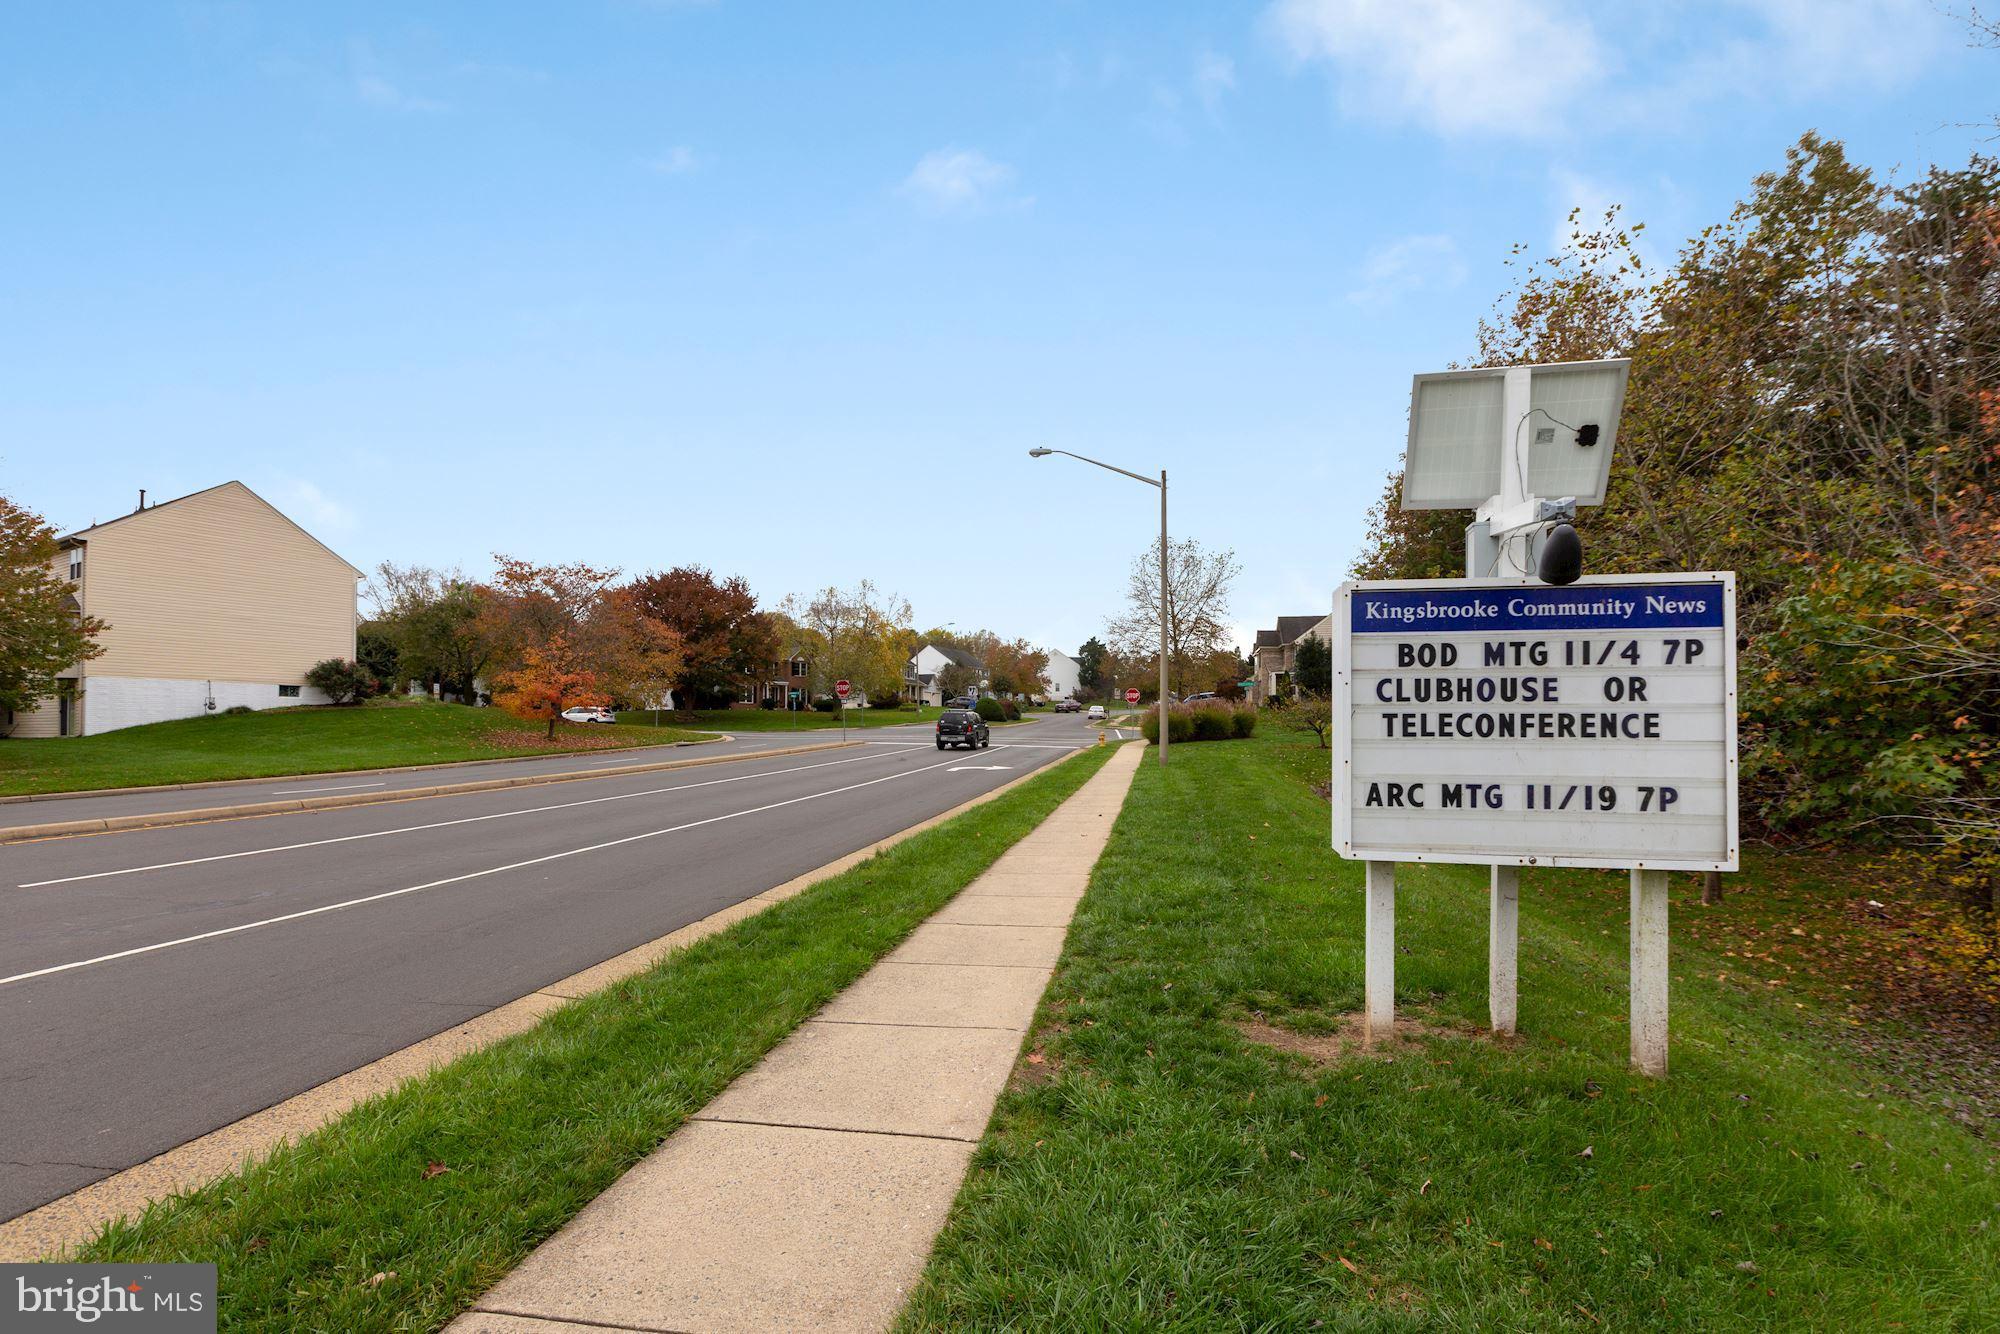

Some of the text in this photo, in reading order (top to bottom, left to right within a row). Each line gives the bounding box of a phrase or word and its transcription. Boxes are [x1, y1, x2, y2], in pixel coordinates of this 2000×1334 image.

[1365, 594, 1706, 623] Kingsbrooke Community News
[1397, 638, 1704, 668] BOD MTG 11/4 7P
[1375, 676, 1648, 703] CLUBHOUSE OR
[1381, 712, 1661, 739] TELECONFERENCE
[1365, 782, 1679, 813] ARC MTG 11/19 7P
